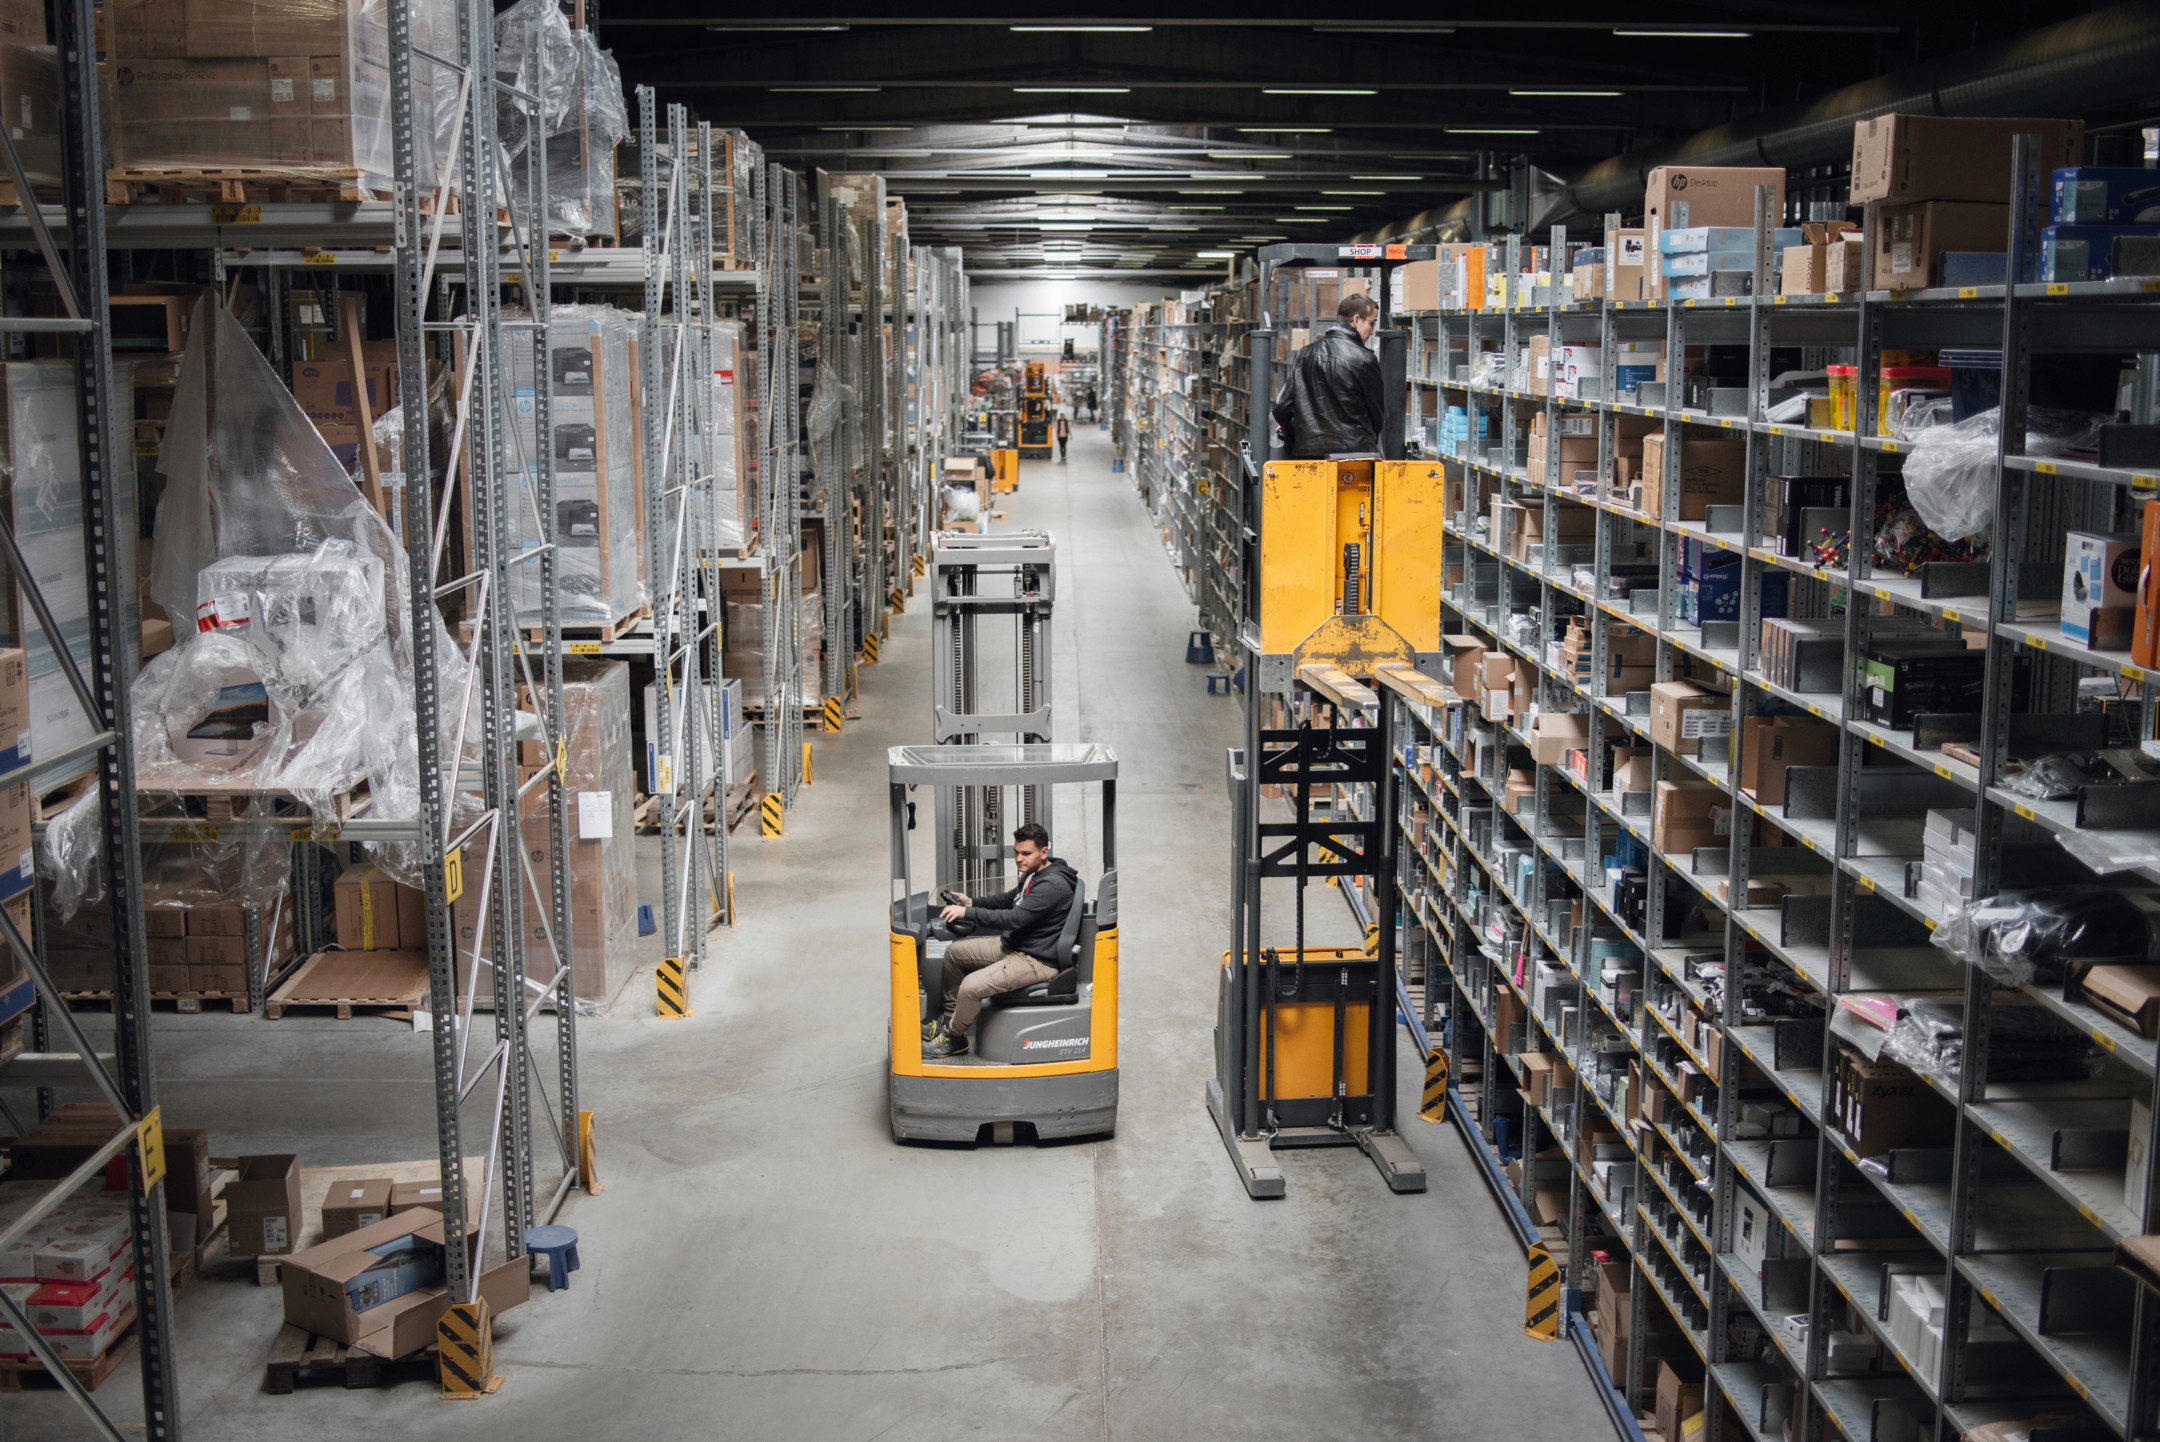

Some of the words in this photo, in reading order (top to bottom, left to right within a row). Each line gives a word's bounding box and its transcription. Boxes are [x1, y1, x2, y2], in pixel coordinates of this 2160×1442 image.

[137, 71, 183, 82] ProDisplay
[1671, 173, 1688, 191] hp
[1690, 178, 1718, 188] Desktop
[1350, 248, 1372, 256] SHOP
[1805, 257, 1813, 290] bowl
[1199, 484, 1207, 494] C
[2118, 574, 2138, 583] Gus
[449, 859, 458, 895] D
[1023, 1036, 1090, 1050] JUNGHEINRICH
[1059, 1048, 1073, 1056] ETV
[1073, 1046, 1086, 1054] 214
[1871, 1085, 1915, 1099] ZyXEL
[143, 1125, 156, 1179] E
